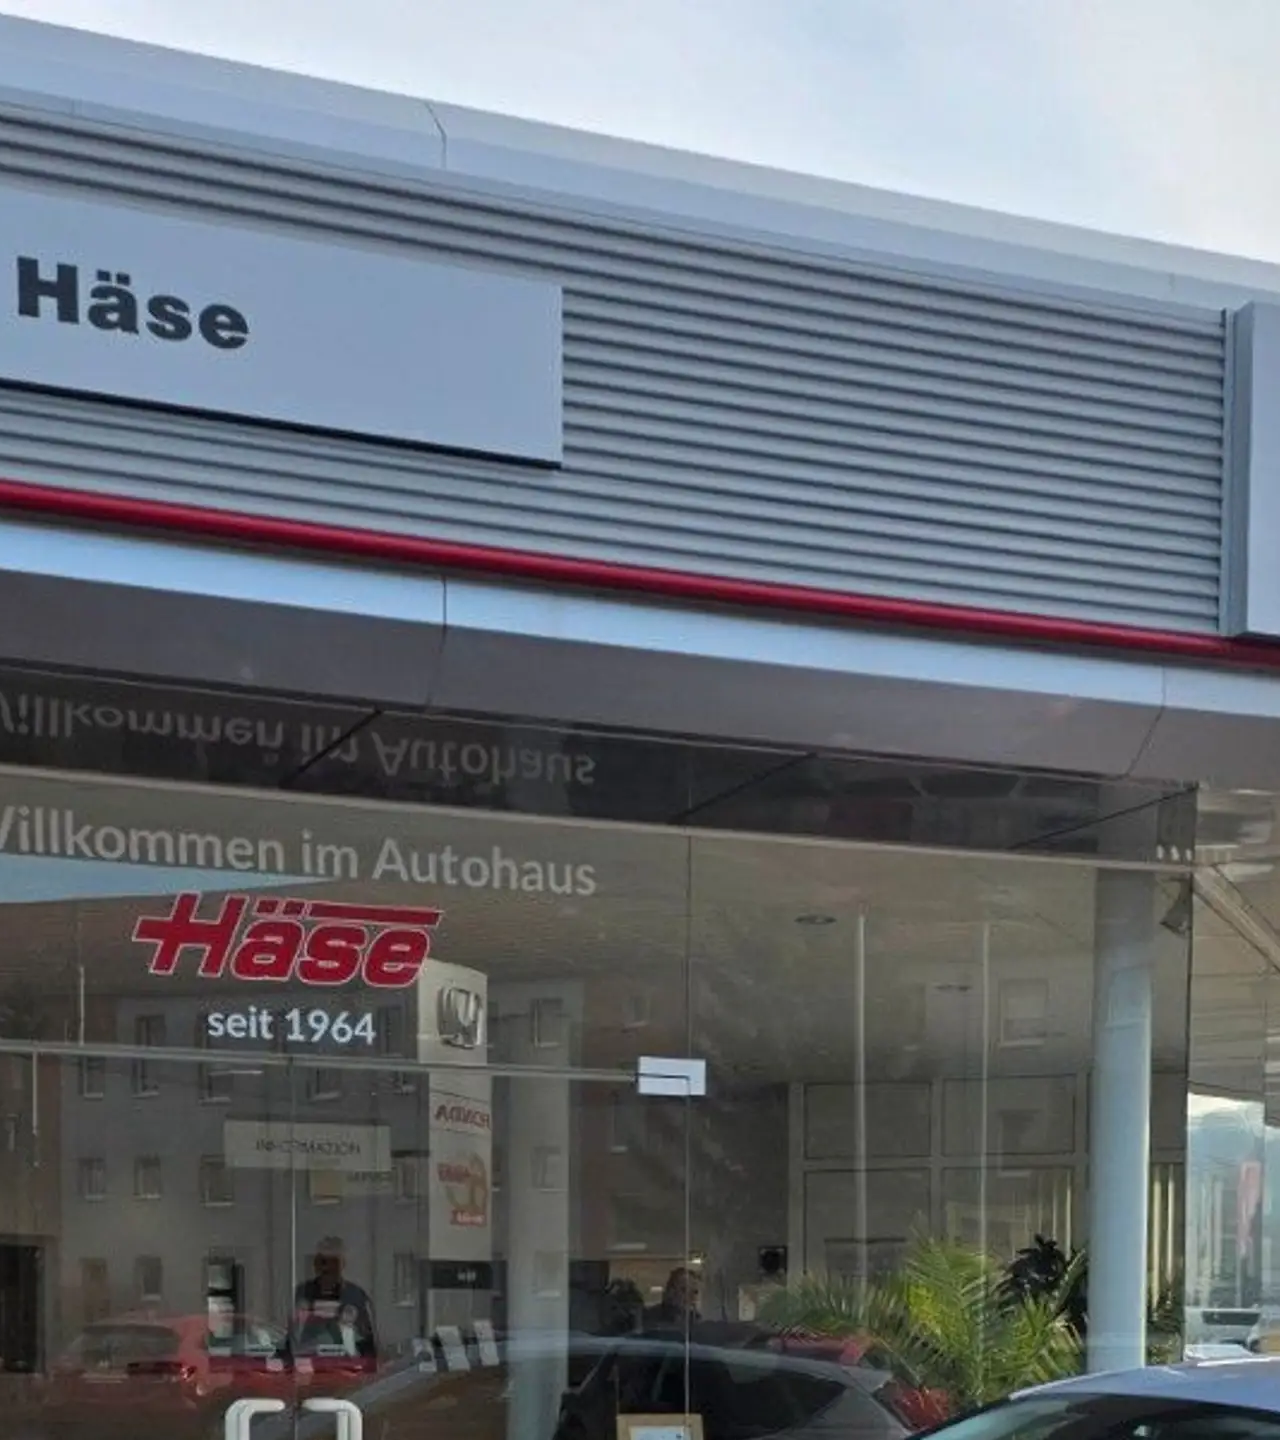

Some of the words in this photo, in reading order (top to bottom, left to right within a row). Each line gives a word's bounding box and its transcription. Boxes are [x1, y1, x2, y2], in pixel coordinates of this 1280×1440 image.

[16, 254, 250, 351] Häse
[301, 828, 359, 879] im
[371, 836, 597, 896] Autohaus
[131, 890, 444, 988] Häse
[207, 1006, 274, 1040] seit
[285, 1007, 377, 1046] 1964
